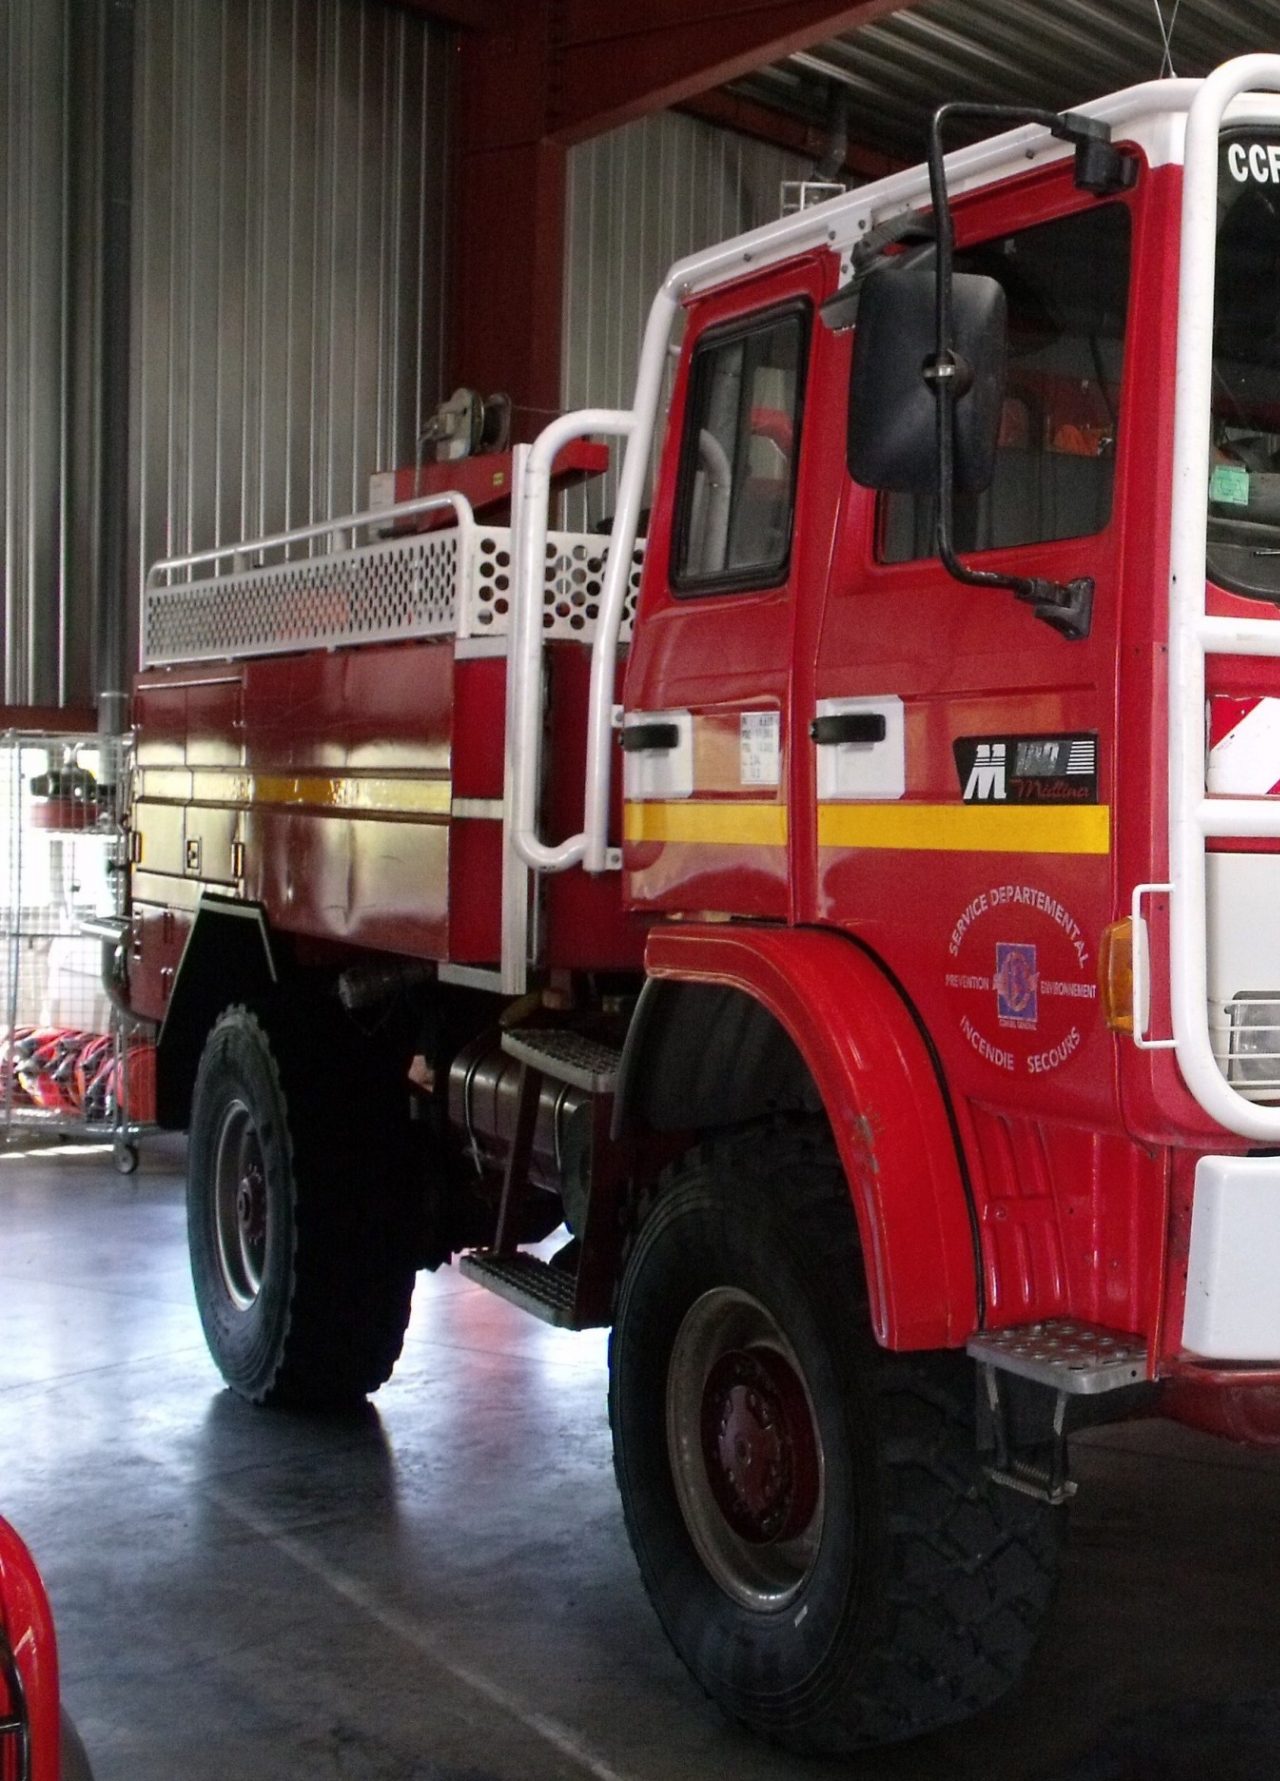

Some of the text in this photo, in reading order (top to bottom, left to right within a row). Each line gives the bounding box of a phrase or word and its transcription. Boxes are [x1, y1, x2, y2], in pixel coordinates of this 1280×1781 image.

[949, 885, 1090, 969] SERVICE DEPARTEMENTAL
[959, 1015, 1080, 1074] INCENDIE SECOURS
